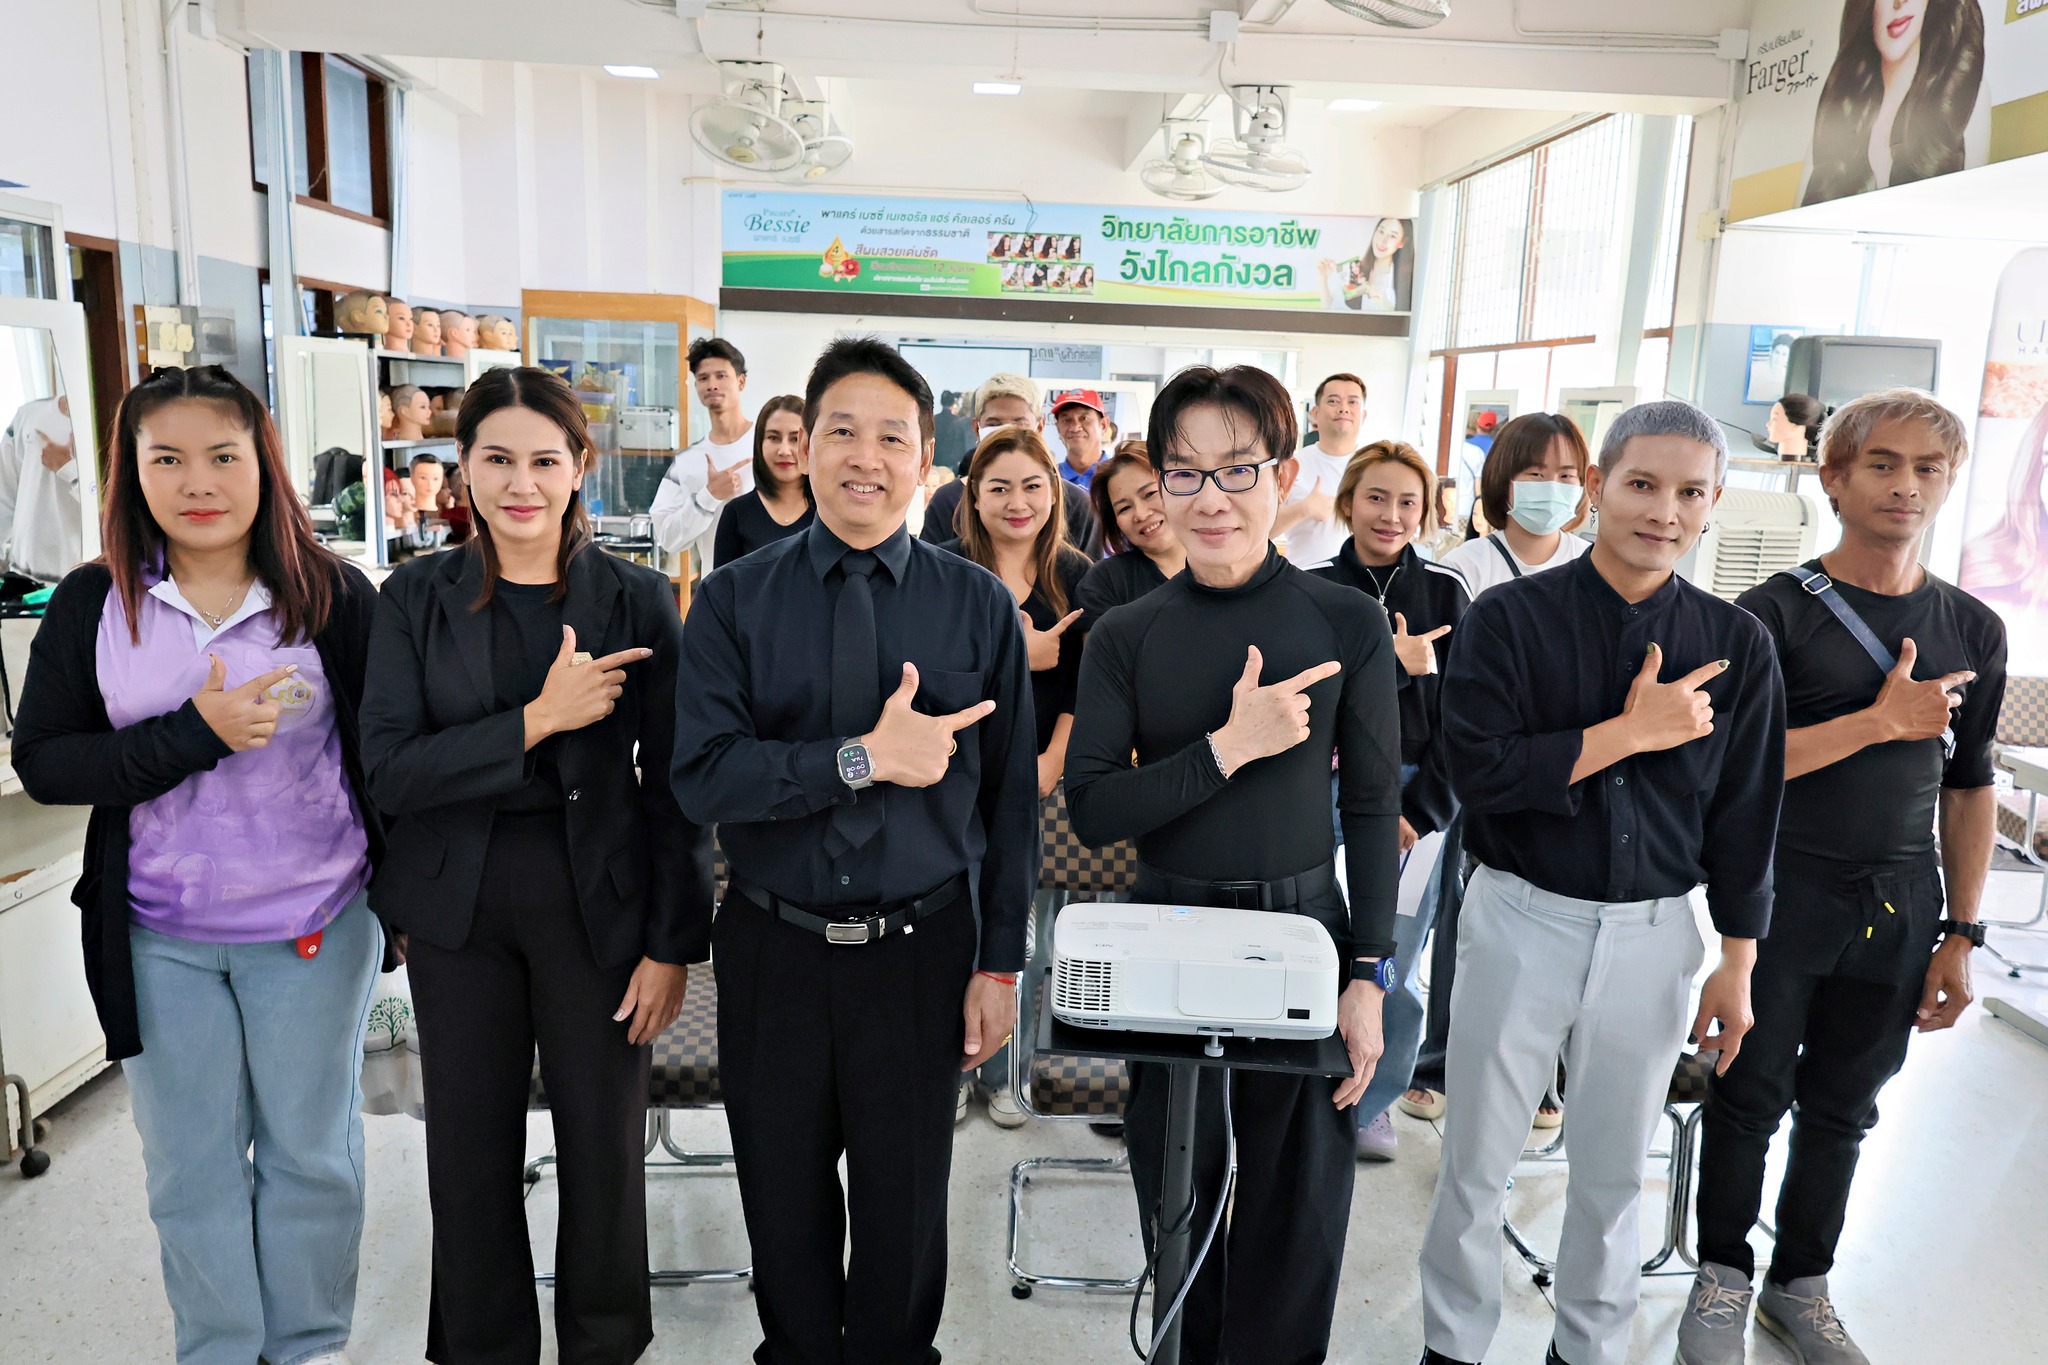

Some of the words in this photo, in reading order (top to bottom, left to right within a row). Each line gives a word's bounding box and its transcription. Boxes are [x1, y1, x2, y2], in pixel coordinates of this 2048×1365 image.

[1746, 49, 1809, 95] Farger
[744, 213, 811, 234] Bessie
[821, 207, 856, 221] พาแคร์
[930, 210, 950, 225] แฮร์
[994, 213, 1016, 227] ครีม
[1100, 213, 1321, 249] วิทยาลัยการอาชีพ
[855, 243, 939, 258] สีผมสวยเด่นชัด
[1120, 248, 1295, 289] วังไกลกังวล
